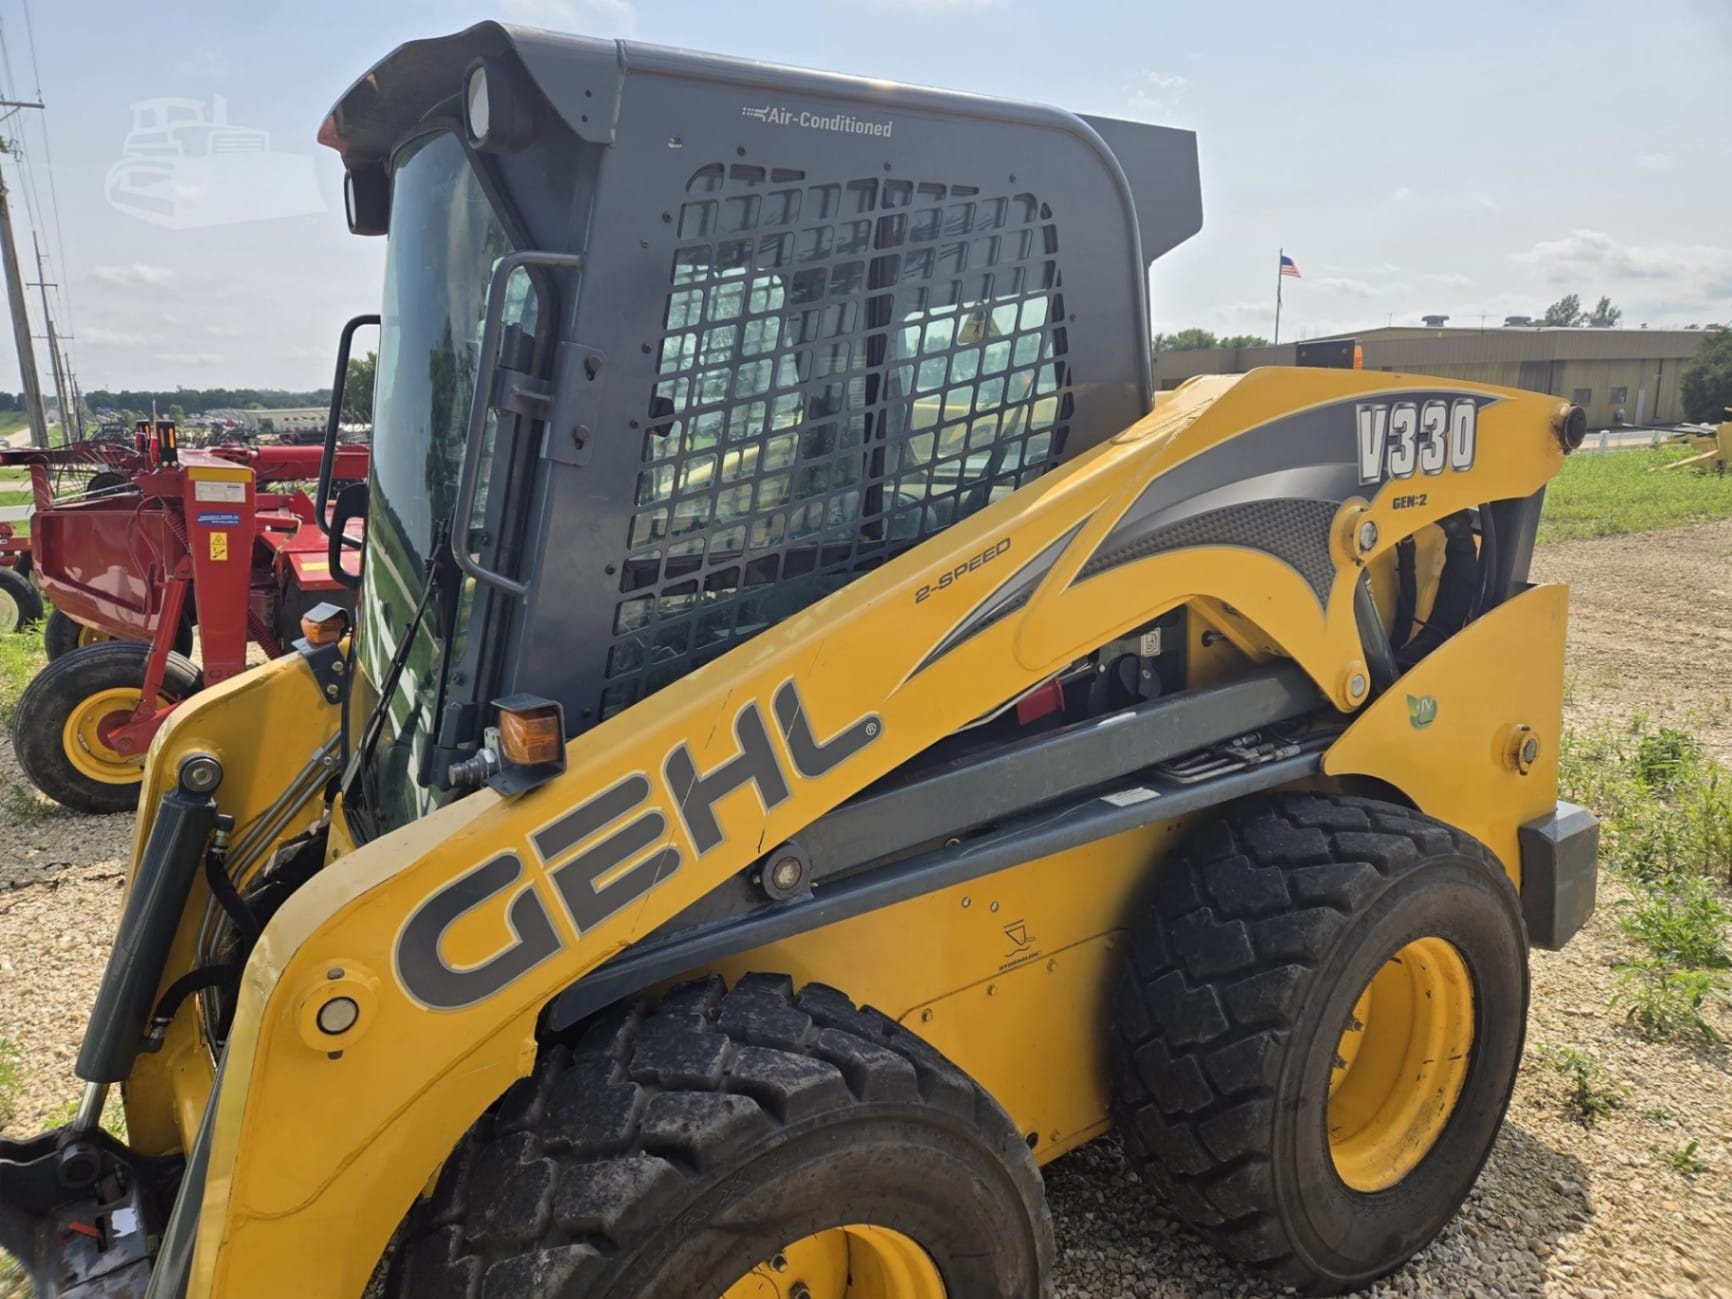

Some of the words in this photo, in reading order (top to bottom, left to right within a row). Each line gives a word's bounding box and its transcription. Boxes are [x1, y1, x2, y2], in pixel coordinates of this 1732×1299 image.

[767, 107, 893, 137] Air-Conditioned
[1356, 398, 1477, 487] V330
[915, 537, 1011, 605] 2-SPEED
